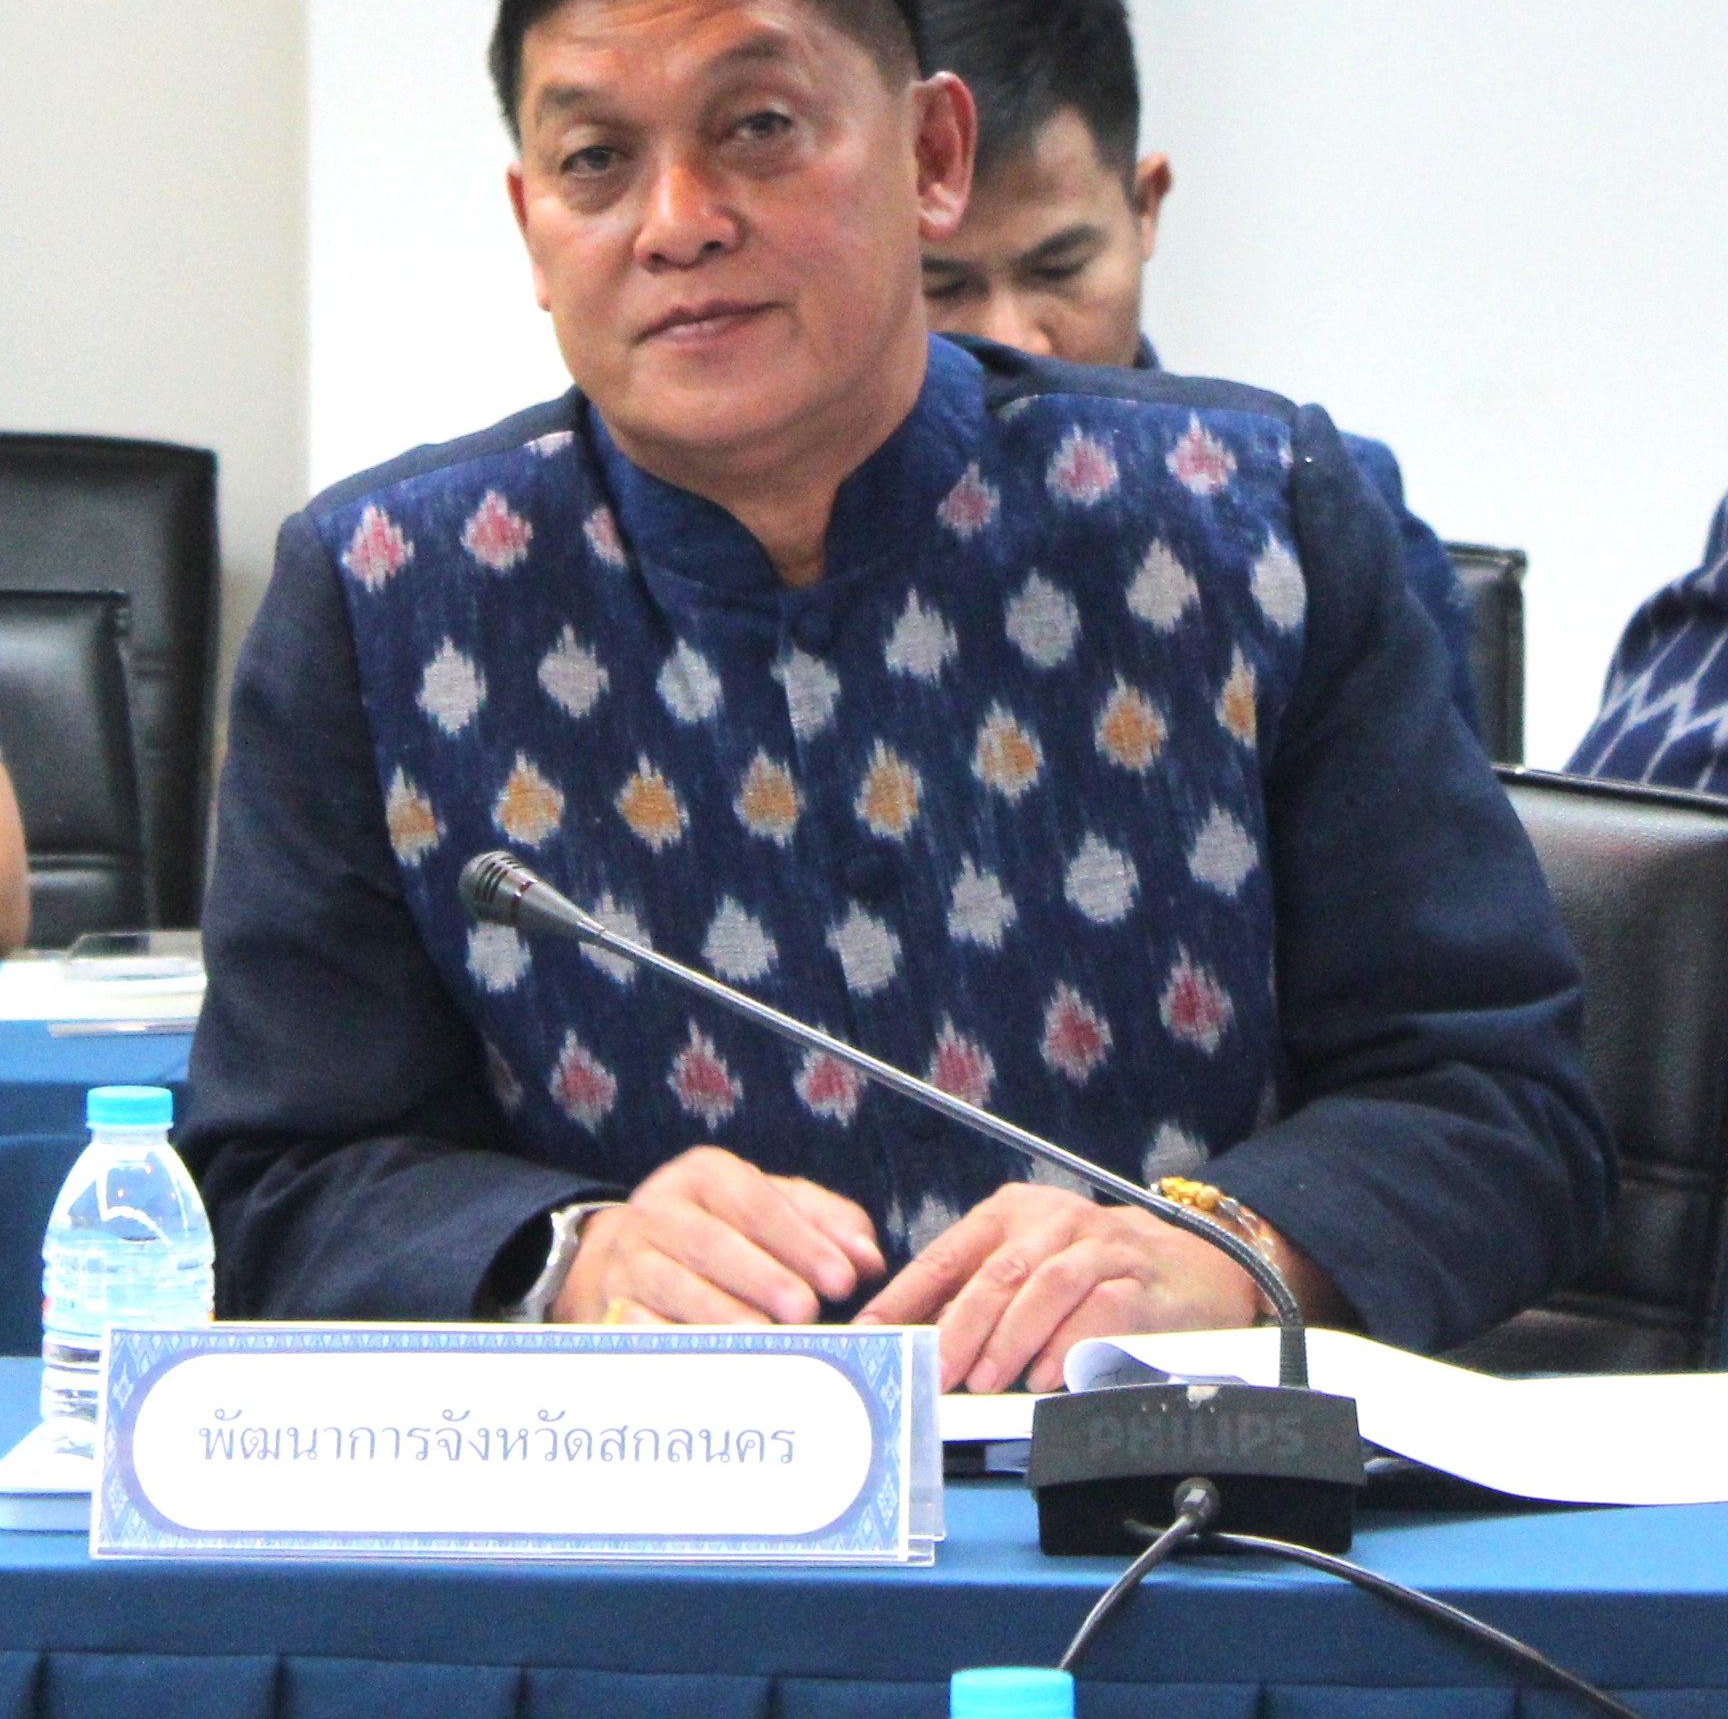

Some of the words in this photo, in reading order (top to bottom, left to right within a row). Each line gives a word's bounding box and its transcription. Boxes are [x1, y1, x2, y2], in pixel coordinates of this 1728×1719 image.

[198, 1407, 798, 1465] พัฒนาการจังหวัดสกลนคร
[1085, 1410, 1306, 1460] PHILIPS
